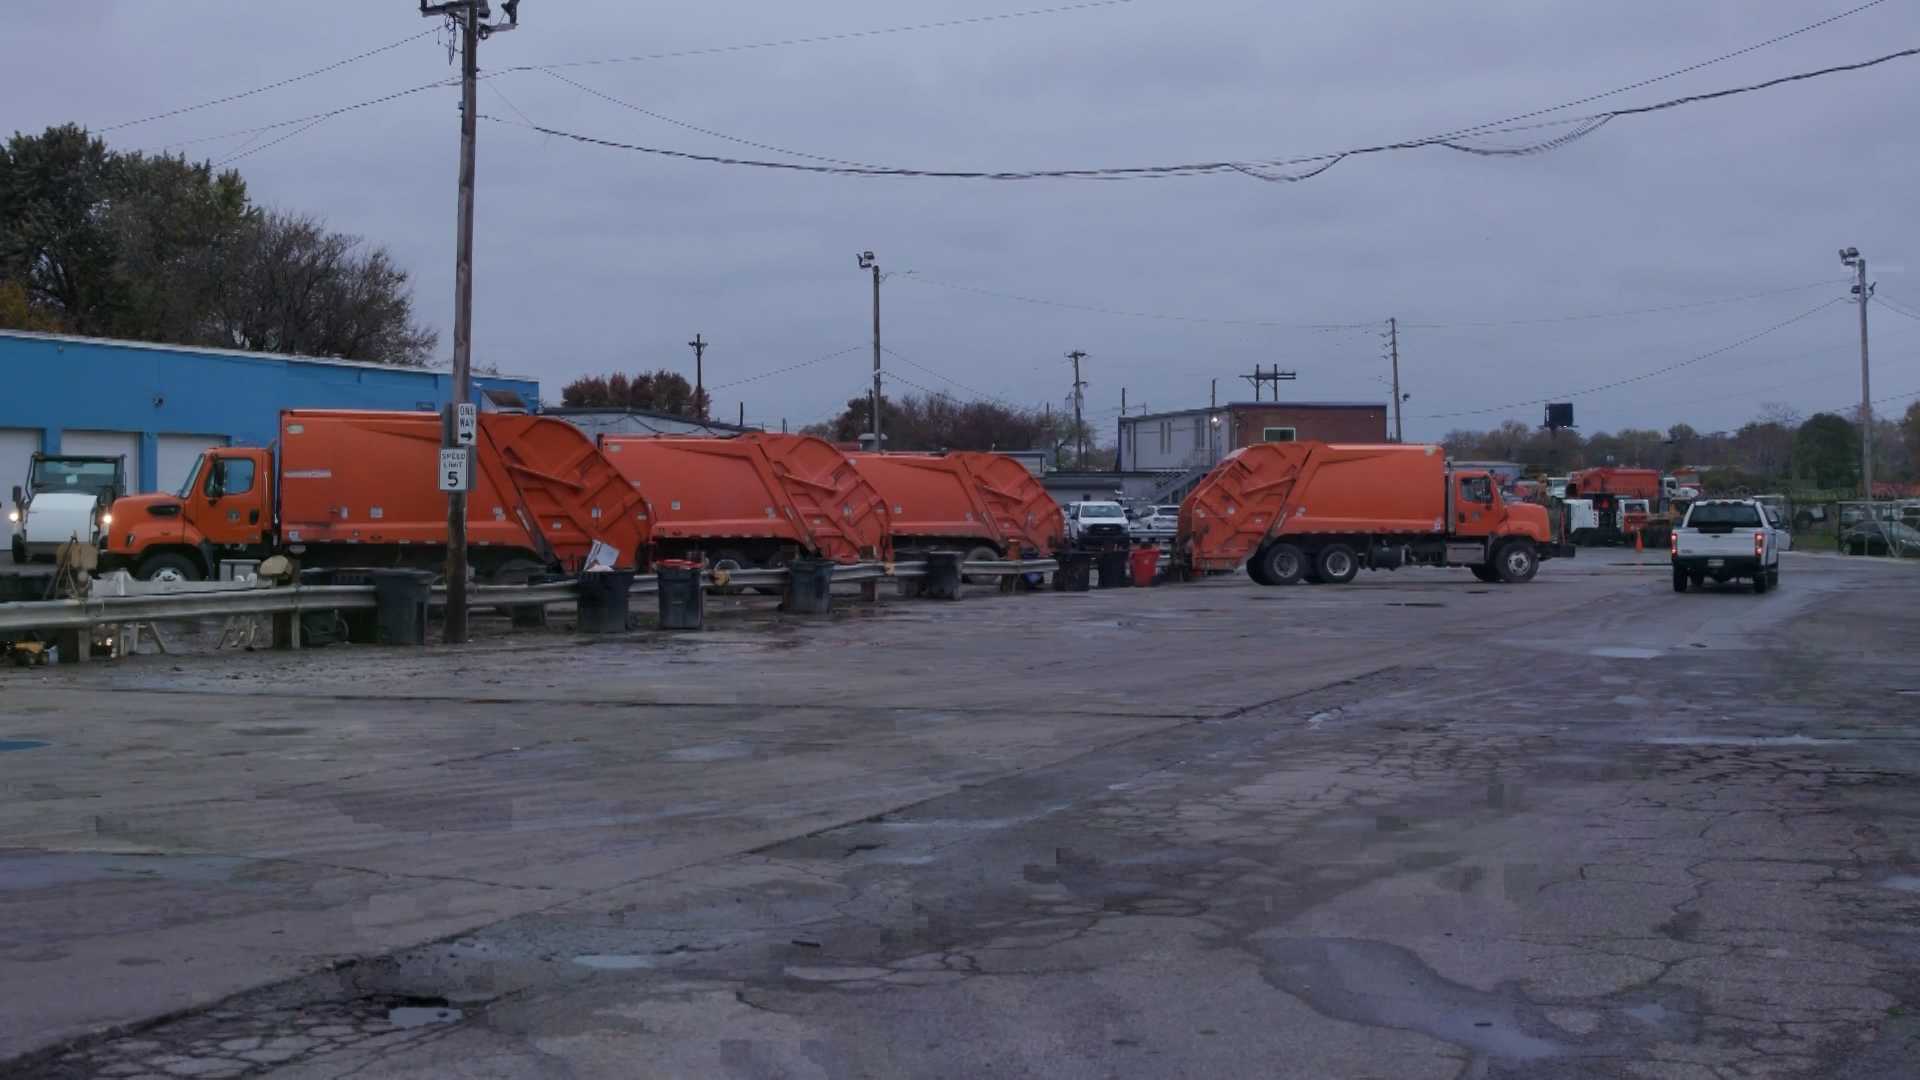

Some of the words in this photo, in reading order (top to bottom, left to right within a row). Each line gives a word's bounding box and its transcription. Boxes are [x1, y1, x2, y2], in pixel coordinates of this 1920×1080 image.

[460, 405, 474, 416] ONE
[460, 417, 474, 428] WAY
[442, 453, 466, 461] SPEED
[443, 461, 463, 469] LIMIT
[447, 471, 459, 488] 5
